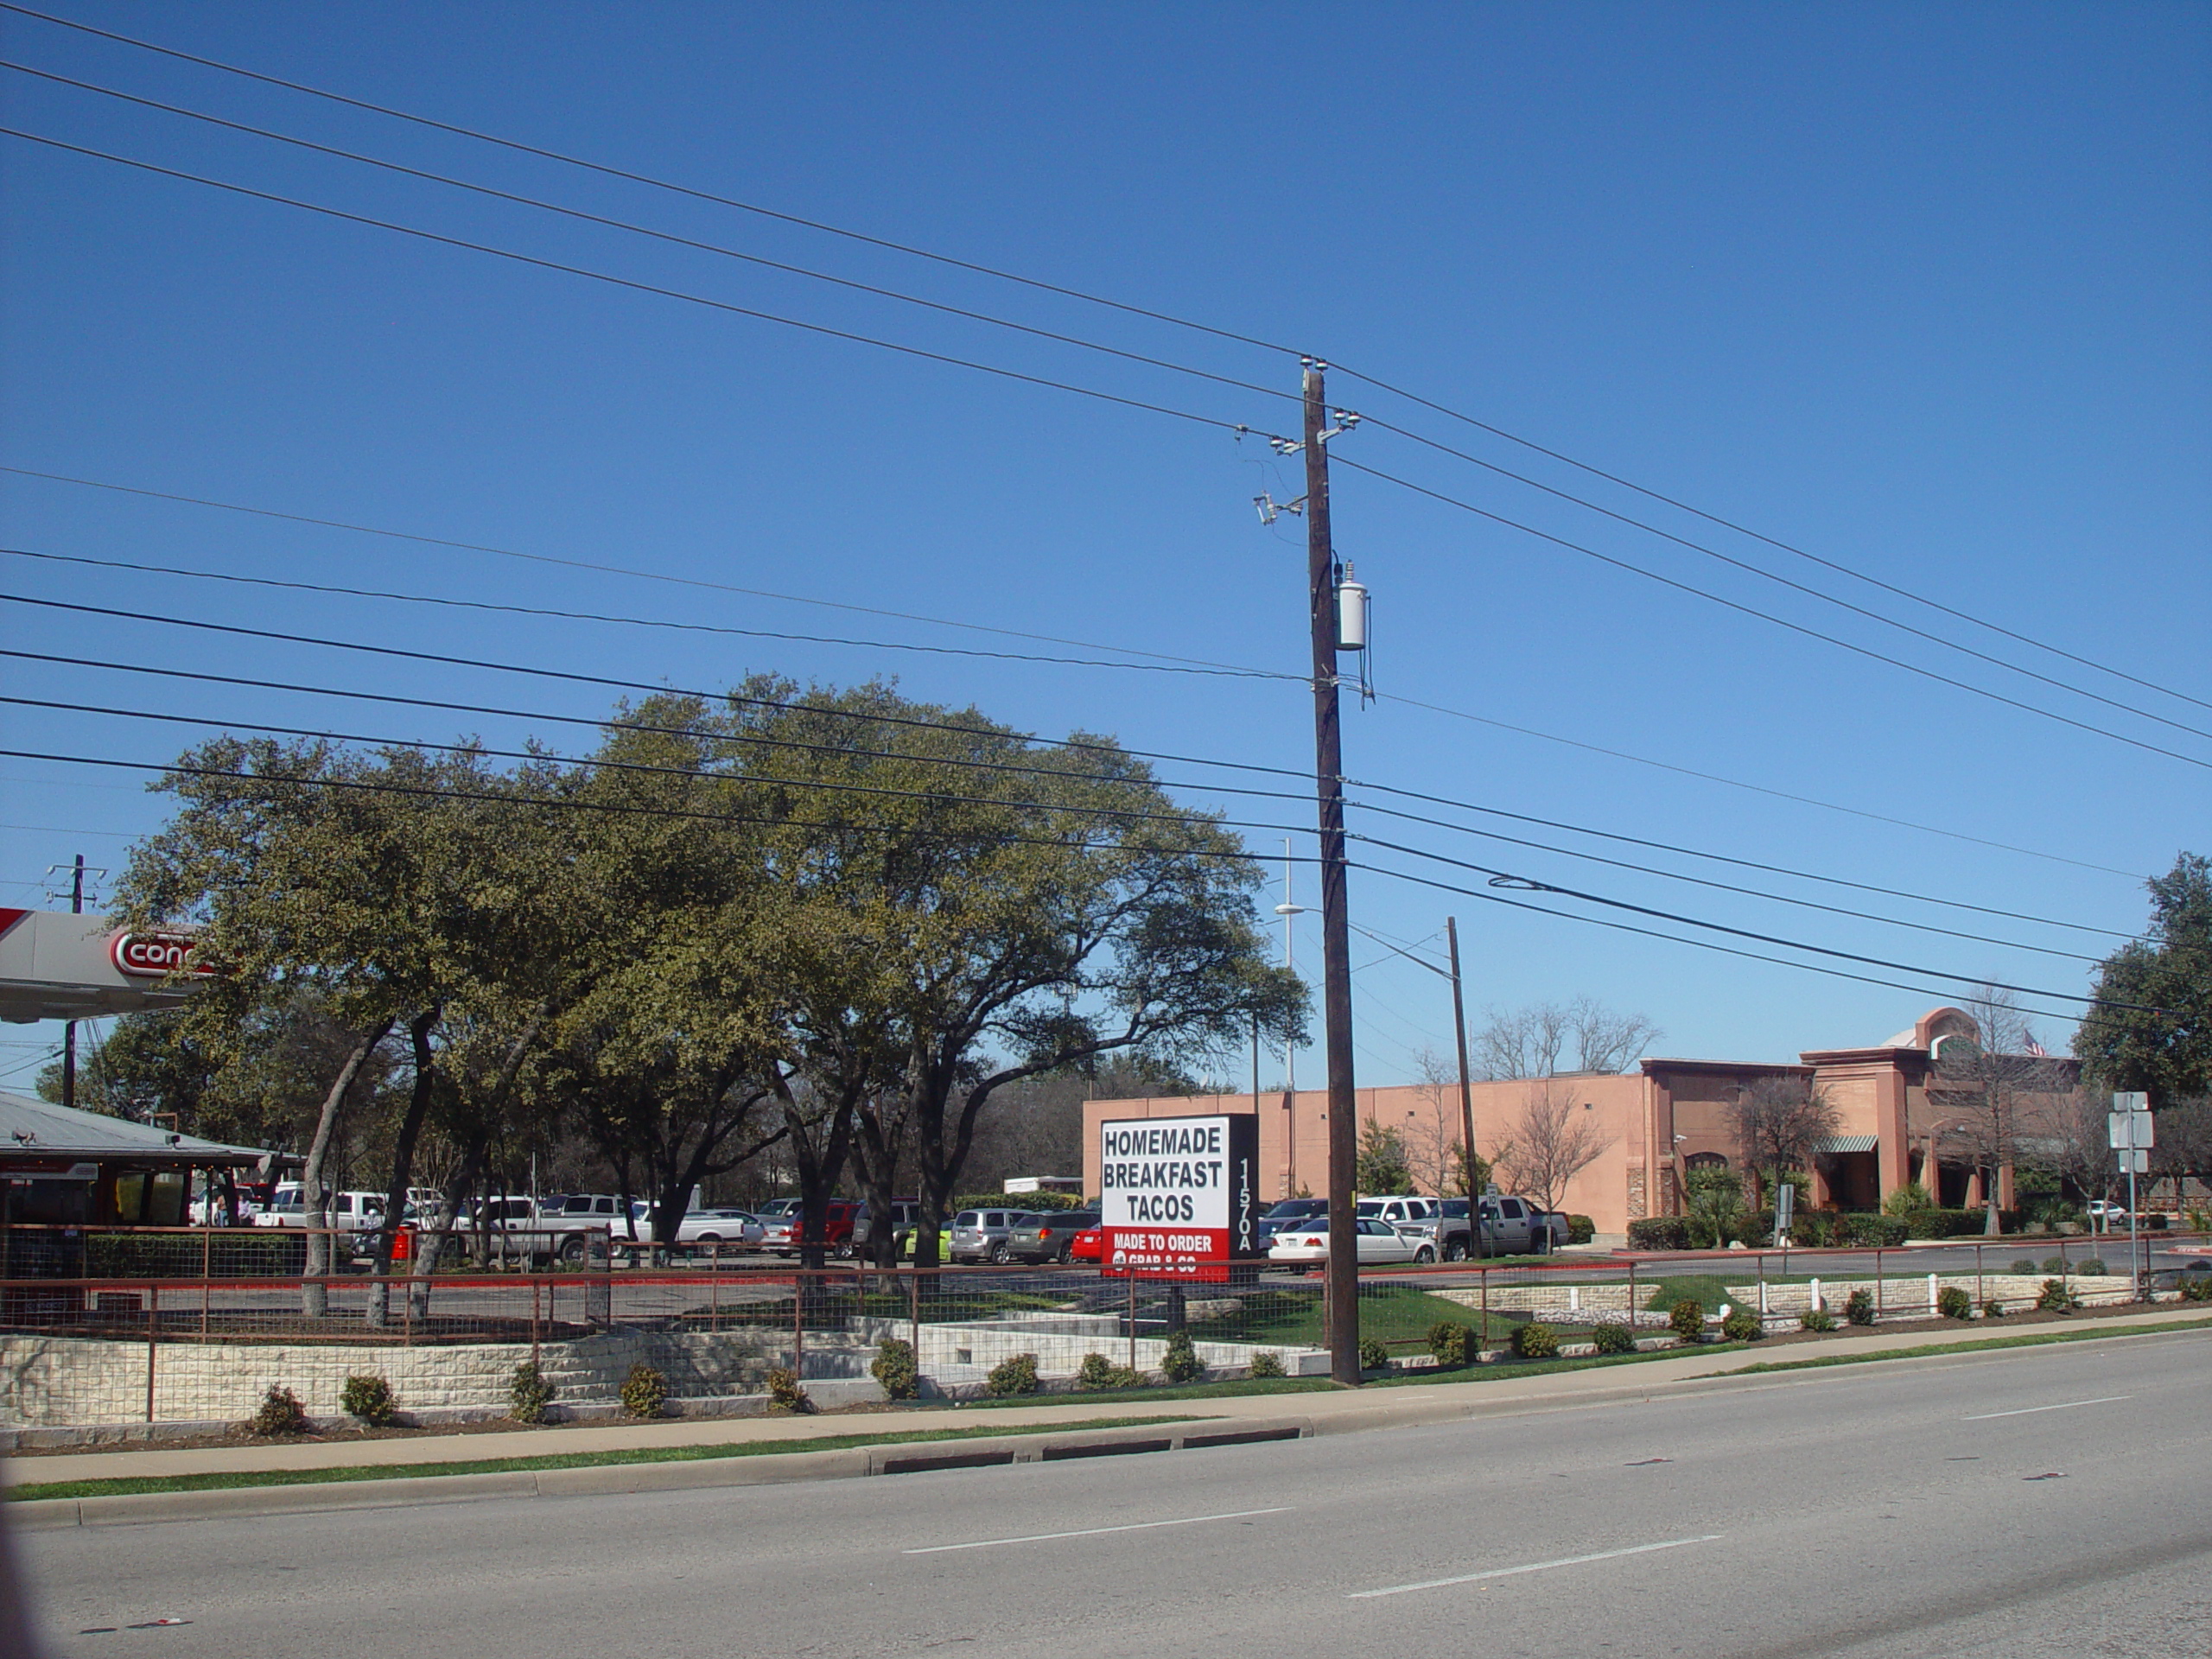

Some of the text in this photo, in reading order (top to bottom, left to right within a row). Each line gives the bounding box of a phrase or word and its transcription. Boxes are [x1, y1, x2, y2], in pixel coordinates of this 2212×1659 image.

[1104, 1126, 1221, 1157] HOMEMADE
[1103, 1160, 1223, 1189] BREAKFAST
[1127, 1194, 1194, 1222] TACOS
[1488, 1195, 1496, 1205] 10
[1114, 1233, 1213, 1253] MADE TO ORDER
